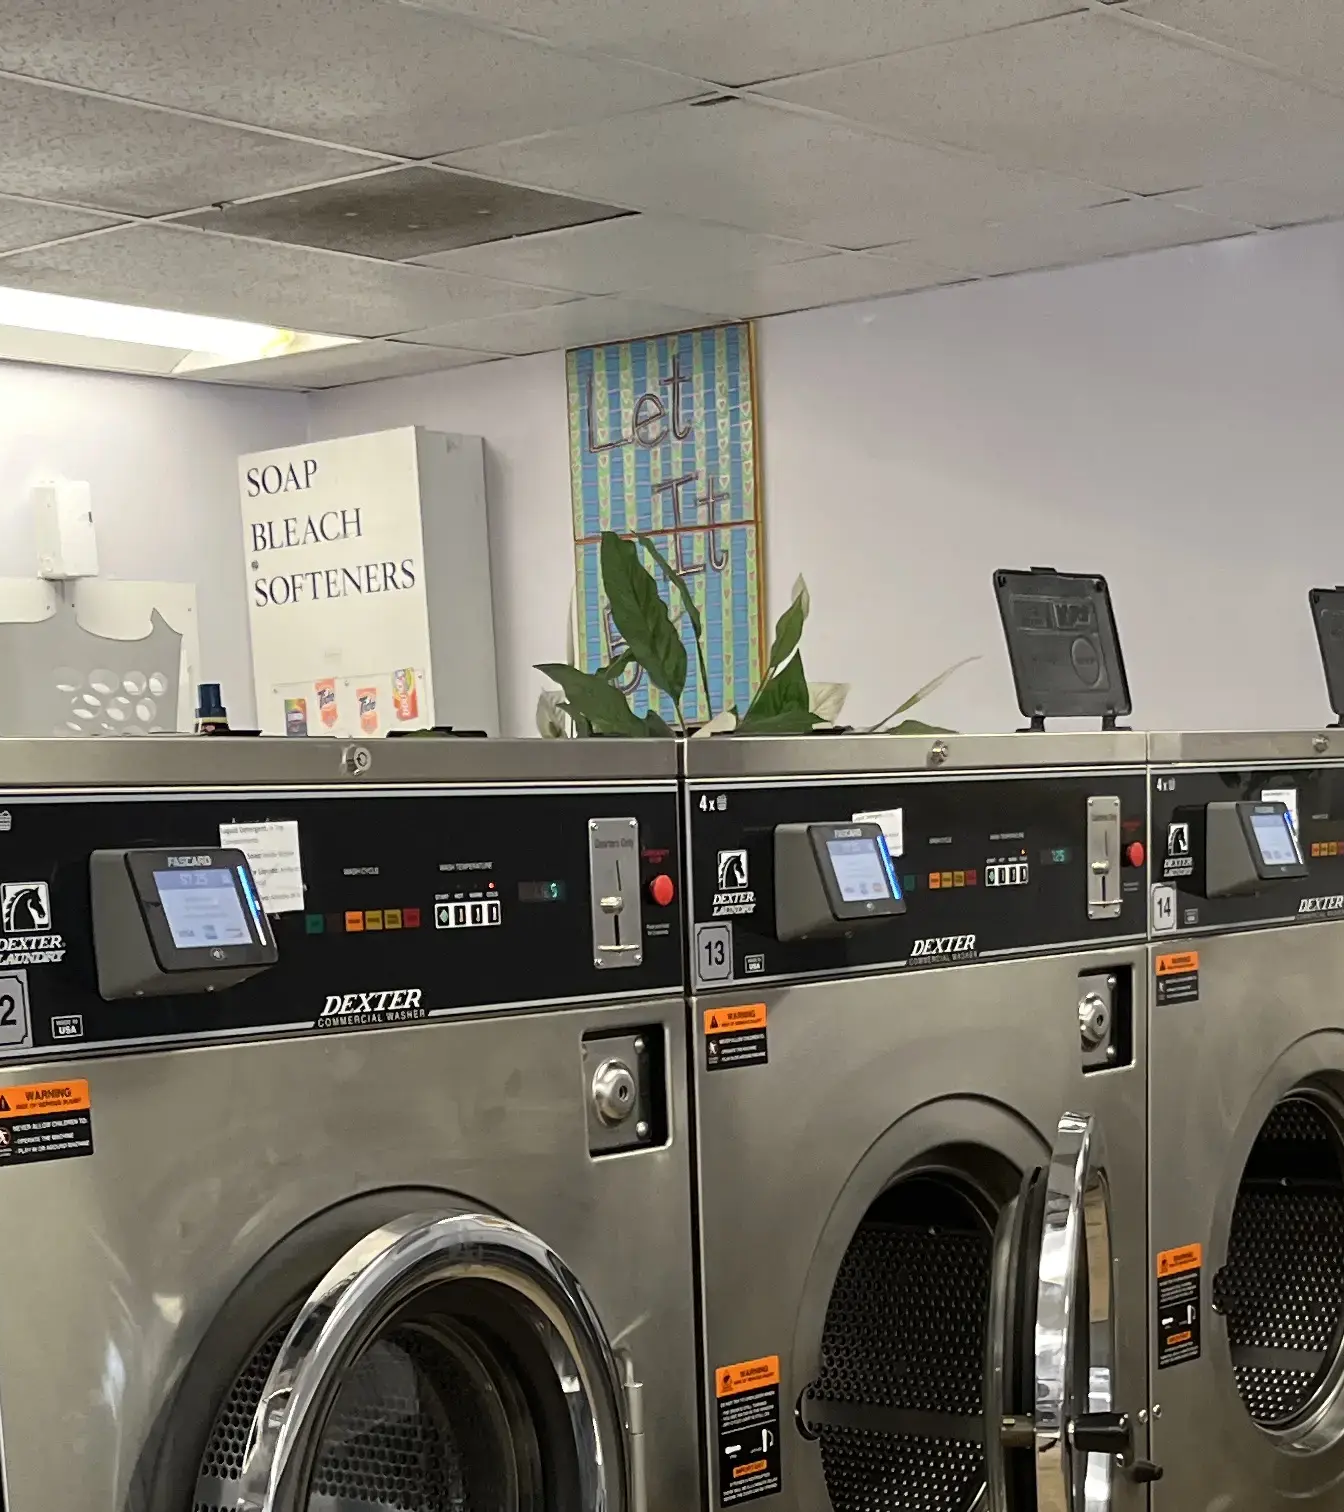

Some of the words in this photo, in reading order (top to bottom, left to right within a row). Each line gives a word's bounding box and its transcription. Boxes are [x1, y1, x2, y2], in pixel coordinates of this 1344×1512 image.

[586, 354, 692, 454] Let
[246, 459, 318, 498] SOAP
[251, 507, 363, 552] BLEACH
[653, 471, 729, 579] It
[254, 558, 417, 608] SOFTENERS
[167, 855, 213, 868] FASCARD
[712, 891, 755, 906] DEXTER
[1156, 897, 1172, 919] 14
[1298, 894, 1344, 914] DEXTER
[705, 940, 725, 966] 13
[910, 934, 976, 957] DEXTER
[319, 988, 423, 1017] DEXTER
[58, 1025, 78, 1035] USA
[317, 1012, 384, 1029] COMMERCIAL
[385, 1008, 427, 1022] WASHER
[25, 1087, 72, 1102] WARNING
